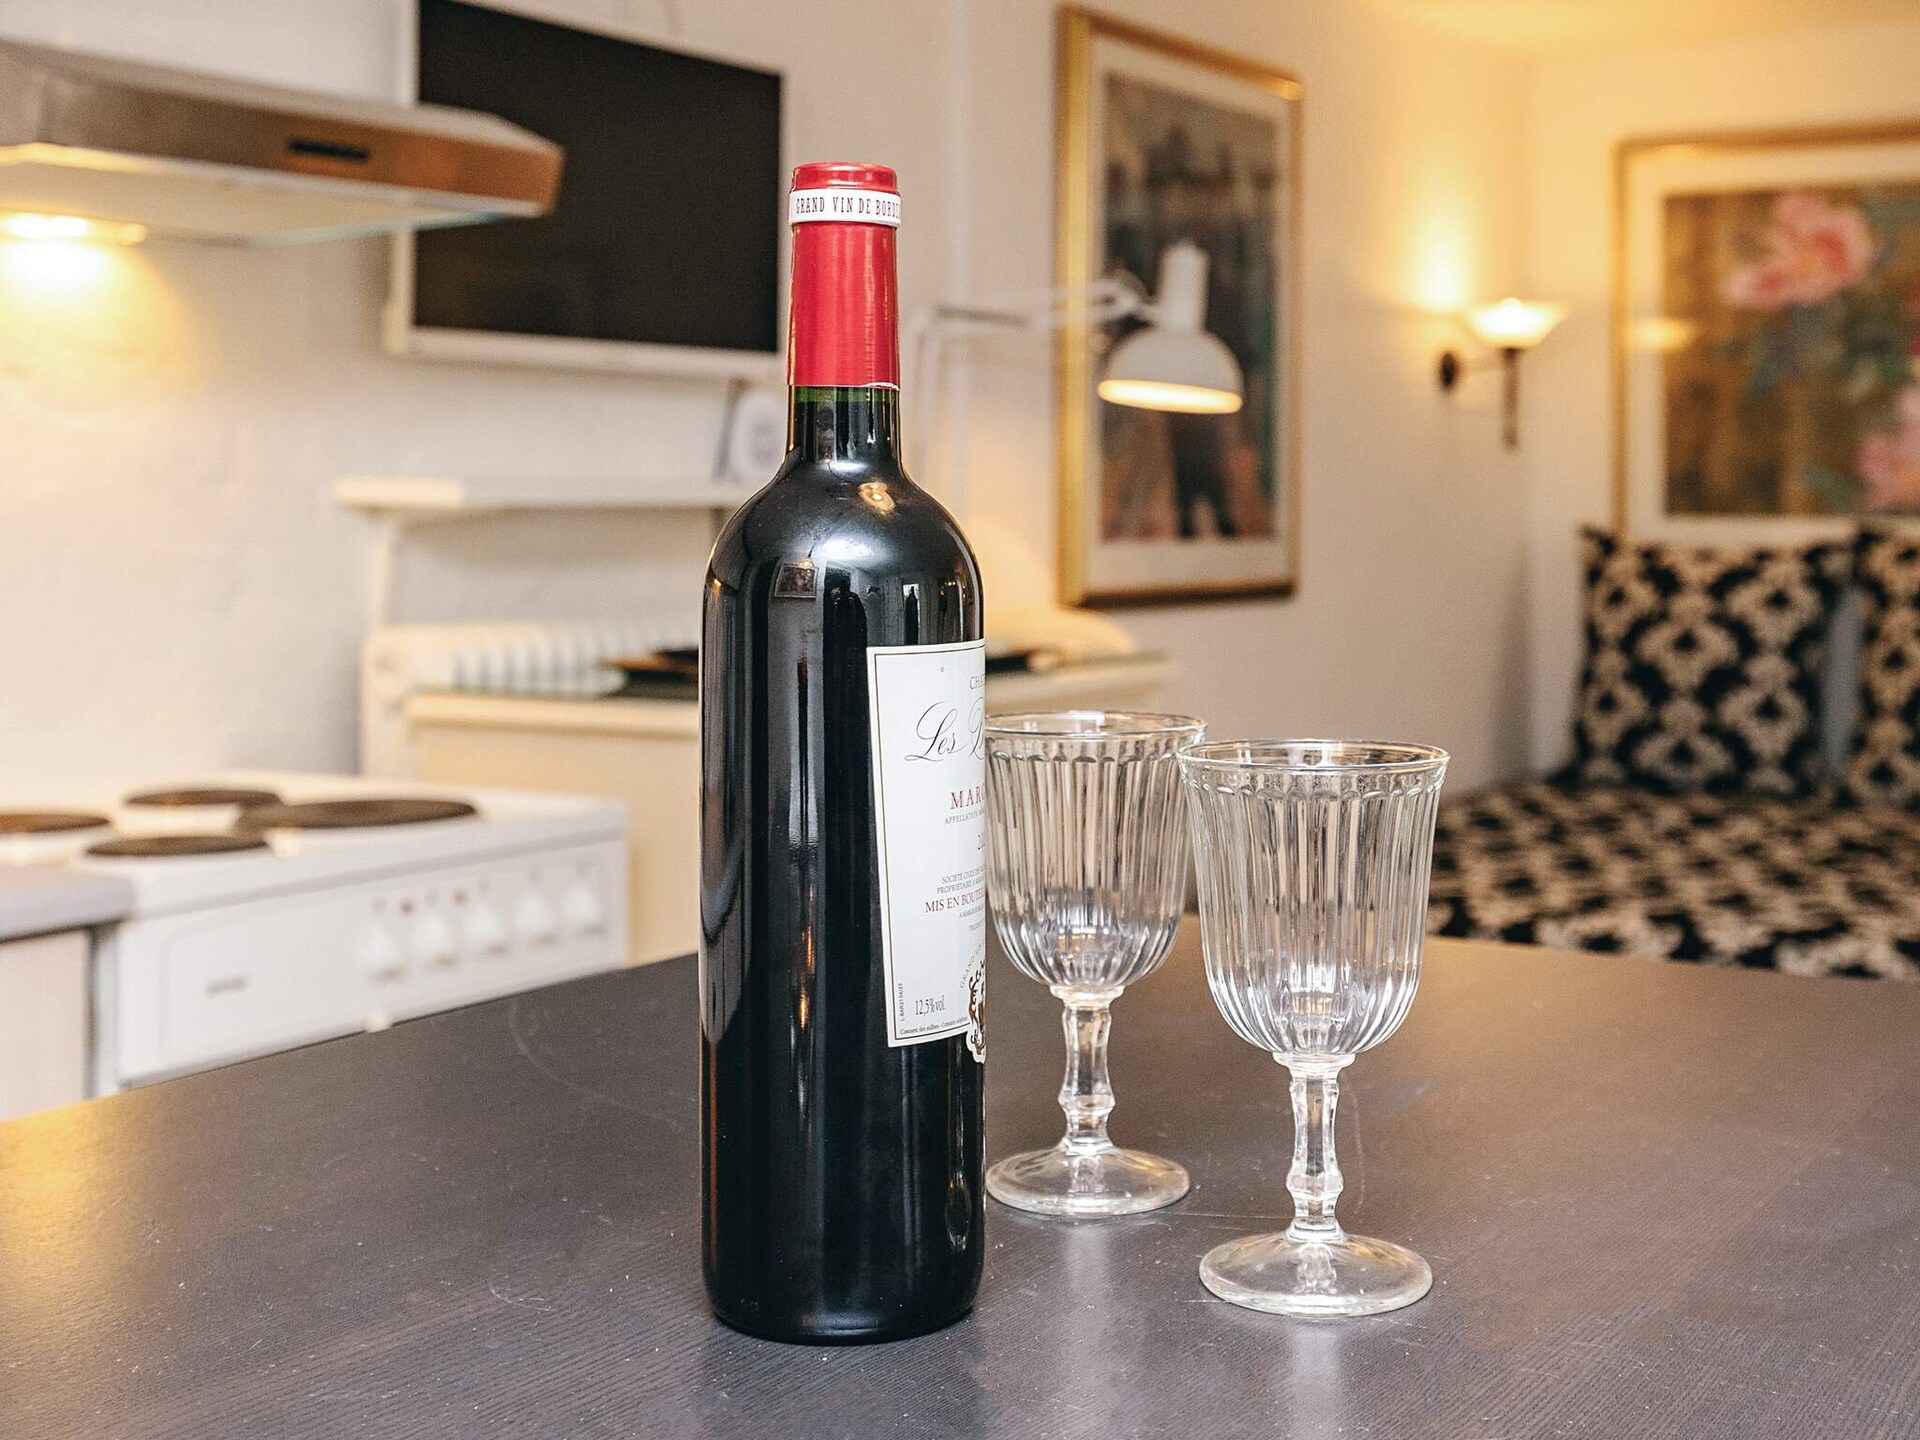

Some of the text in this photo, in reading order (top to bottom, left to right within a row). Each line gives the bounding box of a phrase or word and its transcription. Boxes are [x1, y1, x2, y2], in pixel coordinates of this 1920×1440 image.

[796, 197, 825, 214] GRAND
[833, 197, 853, 213] VIN
[859, 198, 871, 214] DE
[904, 701, 967, 762] Les
[925, 899, 944, 913] MIS
[947, 896, 960, 909] EN
